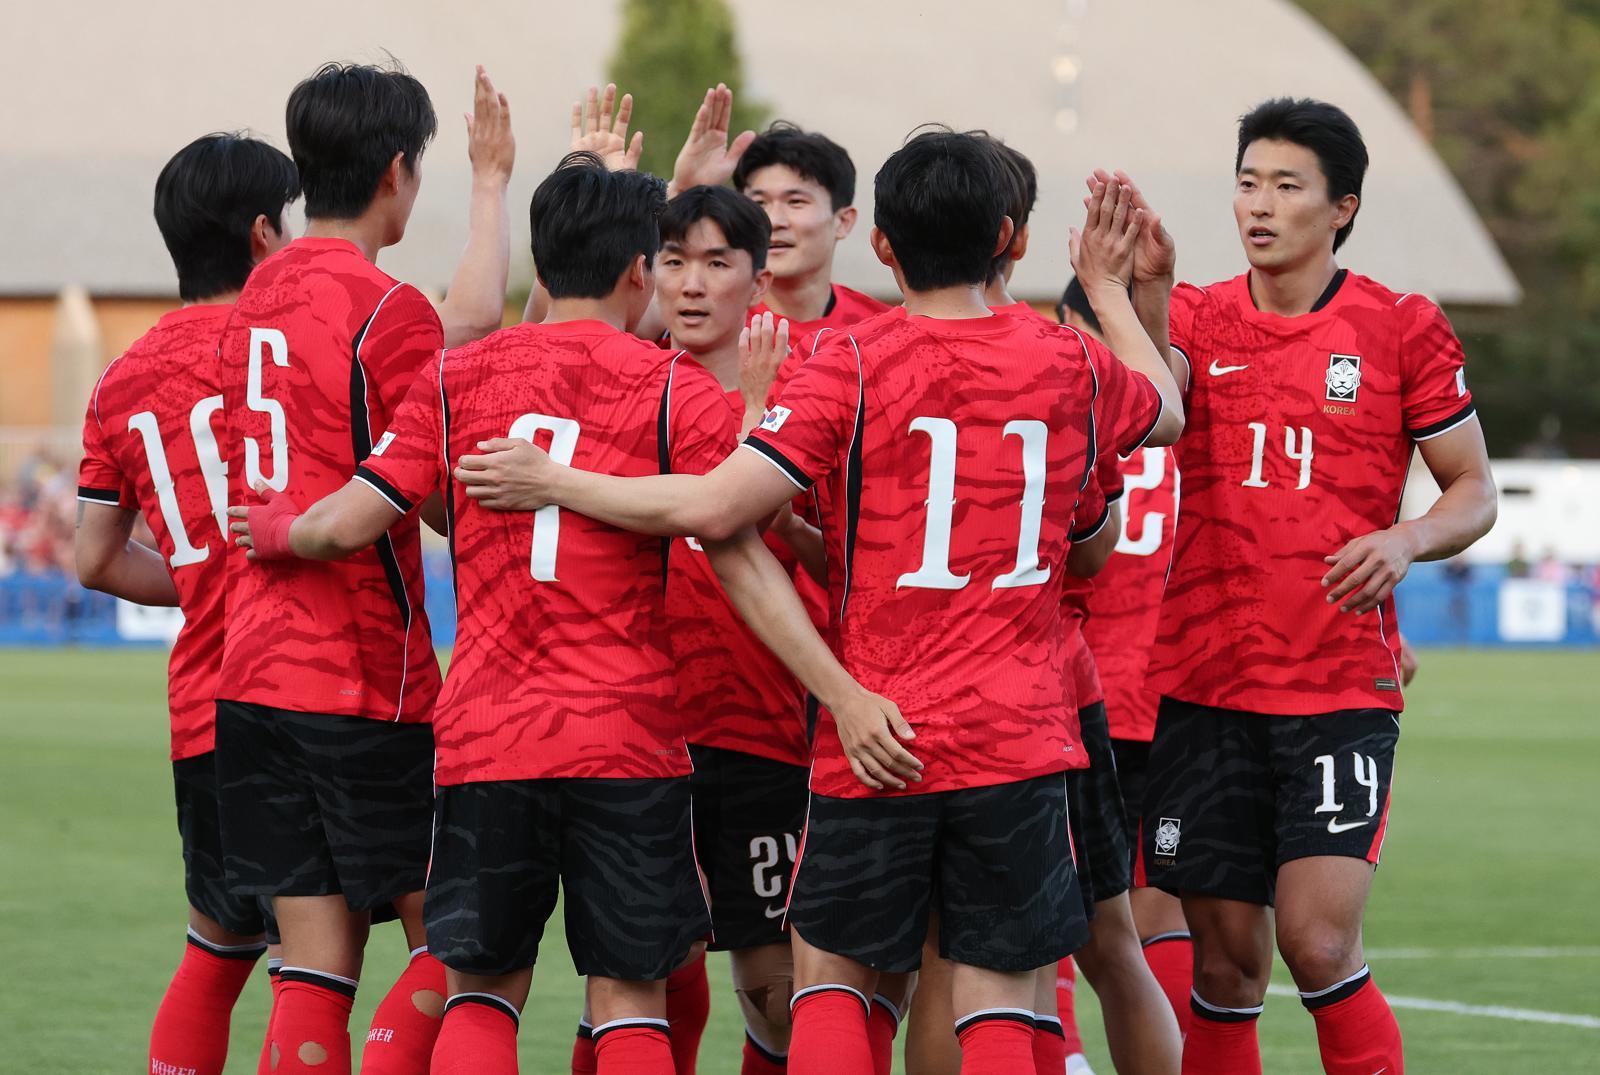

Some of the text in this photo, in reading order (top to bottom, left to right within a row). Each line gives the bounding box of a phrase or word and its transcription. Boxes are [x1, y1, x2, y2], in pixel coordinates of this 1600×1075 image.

[244, 327, 290, 493] 5
[1323, 404, 1356, 417] KOREA
[1241, 422, 1314, 490] 14
[896, 416, 1051, 592] 11
[1314, 751, 1379, 818] 14
